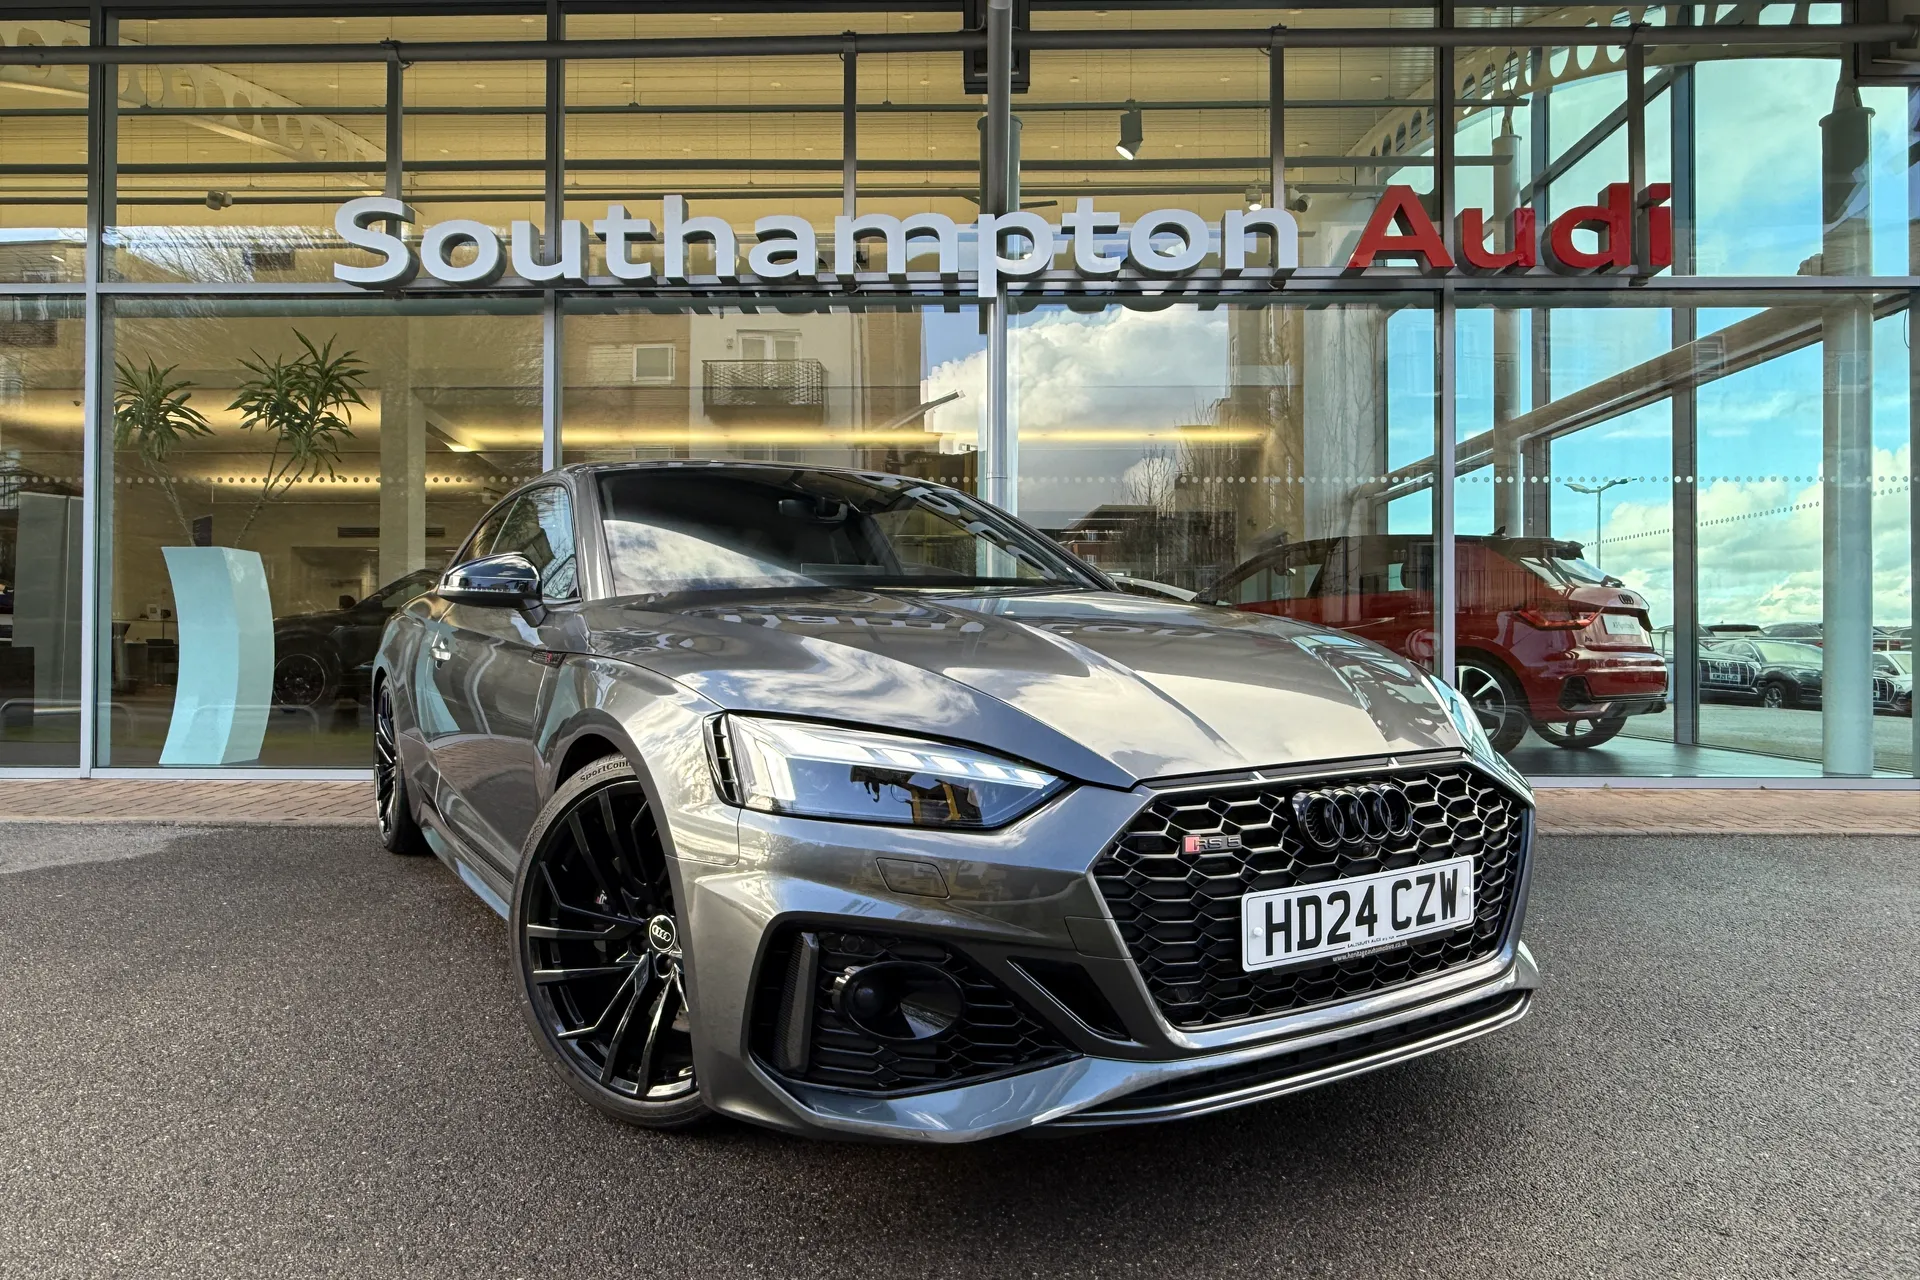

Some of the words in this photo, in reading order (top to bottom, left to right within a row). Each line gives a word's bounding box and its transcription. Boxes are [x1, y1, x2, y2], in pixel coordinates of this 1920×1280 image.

[333, 194, 1299, 299] Southampton
[1348, 183, 1672, 274] Audi
[1193, 838, 1222, 850] RS
[1226, 836, 1240, 848] 5
[1265, 884, 1378, 957] HD24
[1391, 868, 1458, 931] CZW
